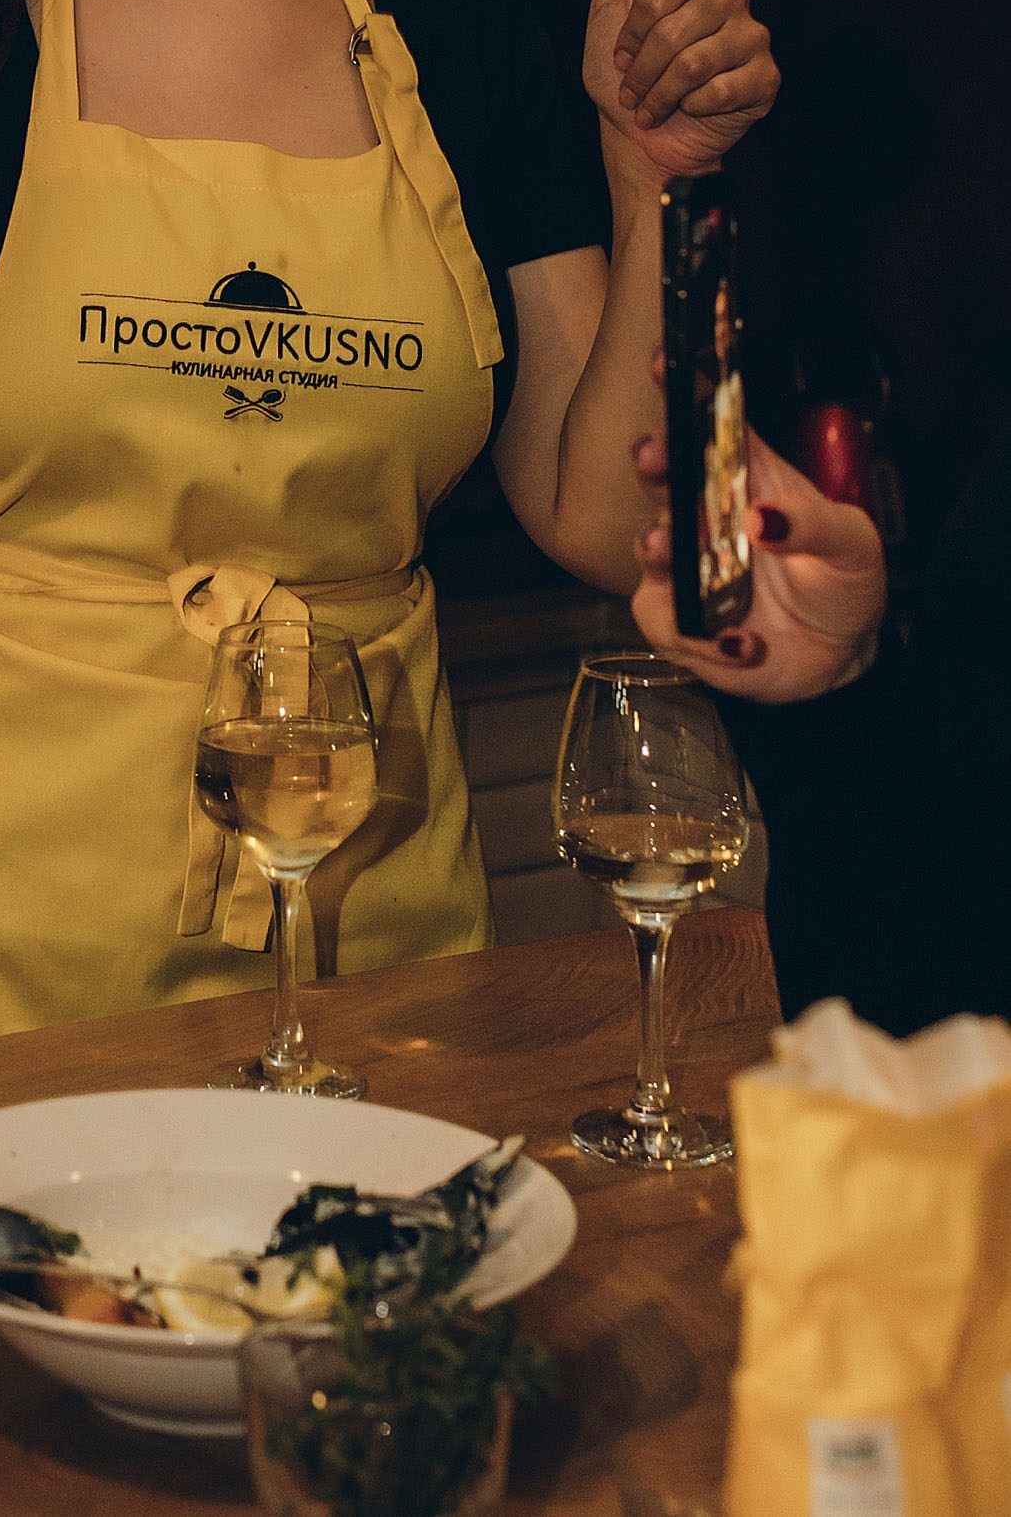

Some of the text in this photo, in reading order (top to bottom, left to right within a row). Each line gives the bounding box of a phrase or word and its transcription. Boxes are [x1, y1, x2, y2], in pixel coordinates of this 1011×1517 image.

[79, 305, 424, 371] ПростоVKUSNO
[171, 360, 338, 390] КУЛИНАРНАЯ СТУДИЯ
